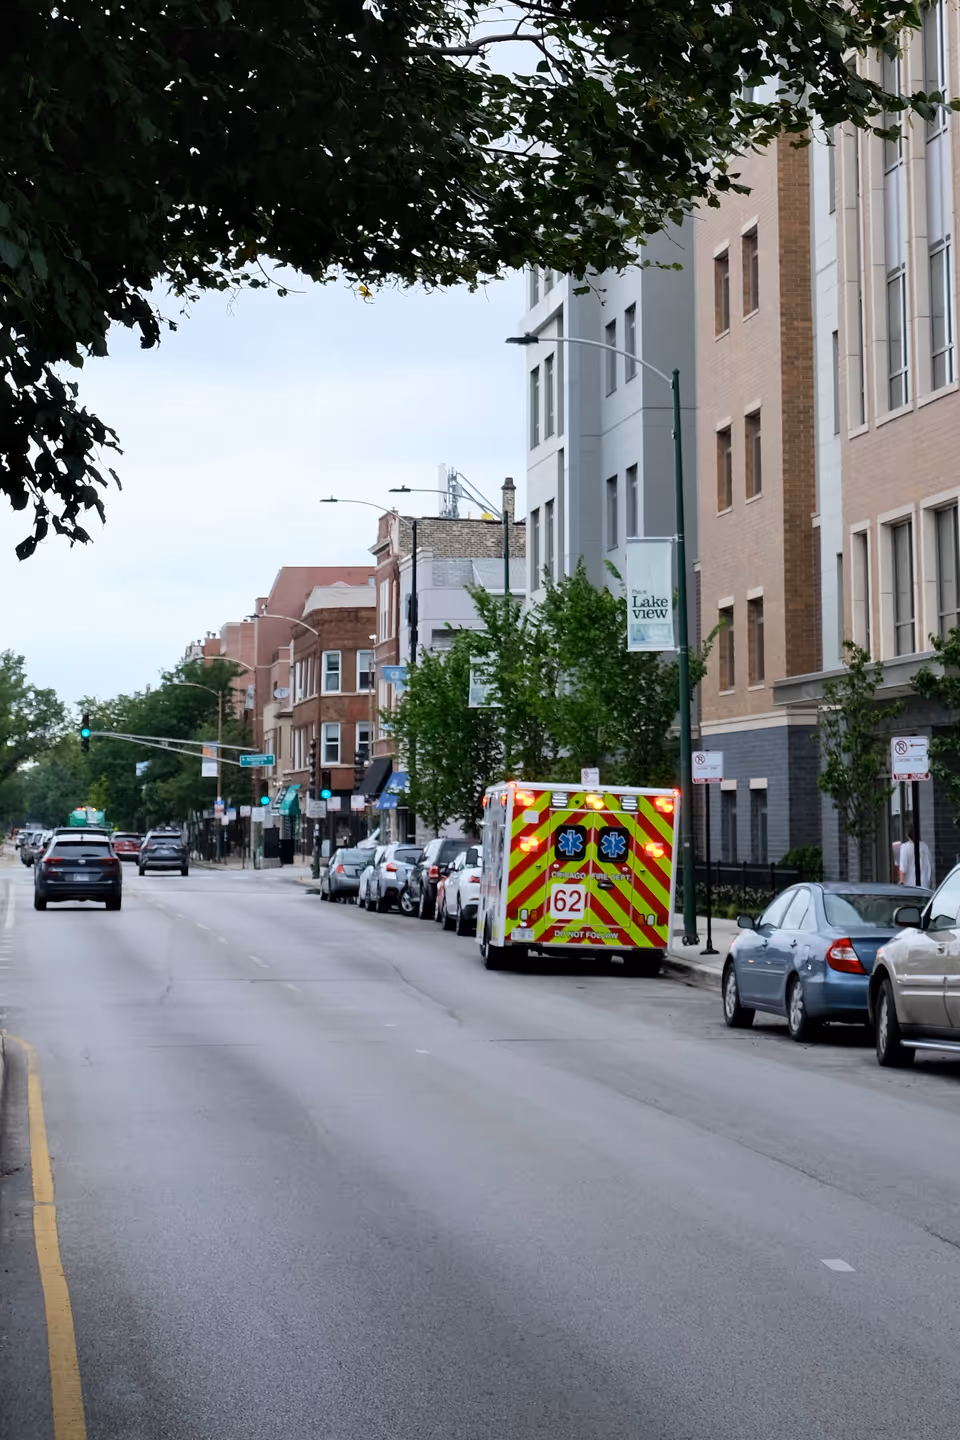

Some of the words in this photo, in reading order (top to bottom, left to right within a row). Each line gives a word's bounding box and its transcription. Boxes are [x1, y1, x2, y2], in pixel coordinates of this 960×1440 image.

[632, 595, 668, 607] Lake
[632, 609, 668, 619] view
[551, 871, 586, 880] CHICAGO
[593, 872, 608, 881] FIRE
[554, 889, 581, 912] 62
[569, 931, 584, 939] NOT
[586, 931, 618, 939] FOLLOW
